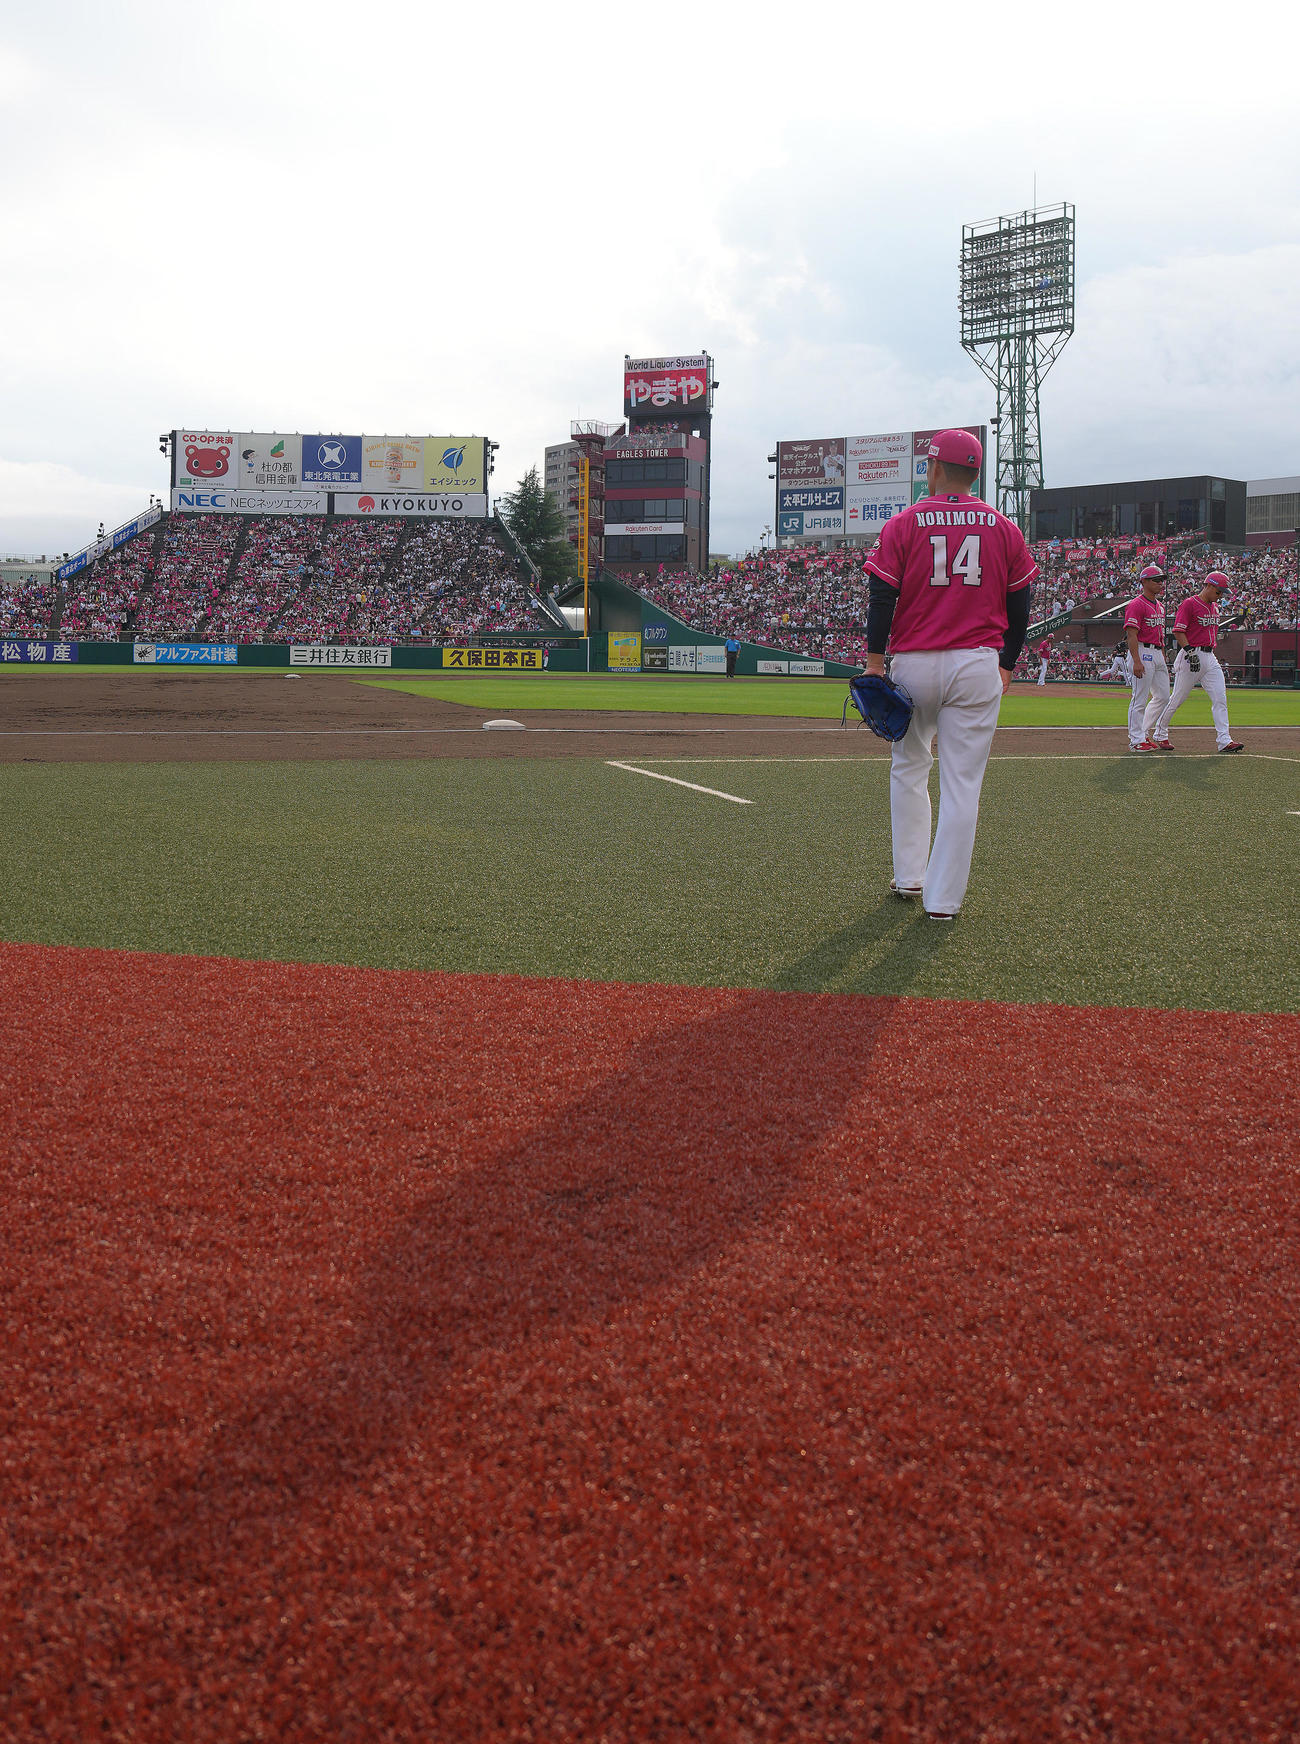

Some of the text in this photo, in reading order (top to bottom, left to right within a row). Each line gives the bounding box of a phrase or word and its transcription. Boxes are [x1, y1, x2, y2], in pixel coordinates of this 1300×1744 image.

[627, 358, 704, 370] World Liquor System
[626, 376, 704, 407] やまや
[916, 438, 931, 448] アク
[616, 449, 669, 458] EAGLES TOWER
[261, 462, 293, 473] 杜の都
[781, 466, 820, 475] スマホアプリ
[255, 474, 297, 485] 信用金庫
[304, 471, 359, 481] 東北発電工業
[430, 478, 477, 486] エイジェック
[178, 494, 226, 507] NEC
[230, 498, 321, 509] NECネッツエスアイ
[783, 491, 841, 507] 太平ビルサービス
[380, 499, 463, 511] KYOKUYO
[783, 518, 800, 528] JR
[805, 518, 842, 529] JR貨物
[915, 511, 997, 528] NORIMOTO
[625, 525, 648, 533] Rakuten
[929, 534, 983, 587] 14
[1, 642, 72, 662] 松物産
[157, 647, 237, 662] アルファス計装
[293, 648, 389, 664] 三井住友銀行
[449, 649, 537, 667] 久保田本店
